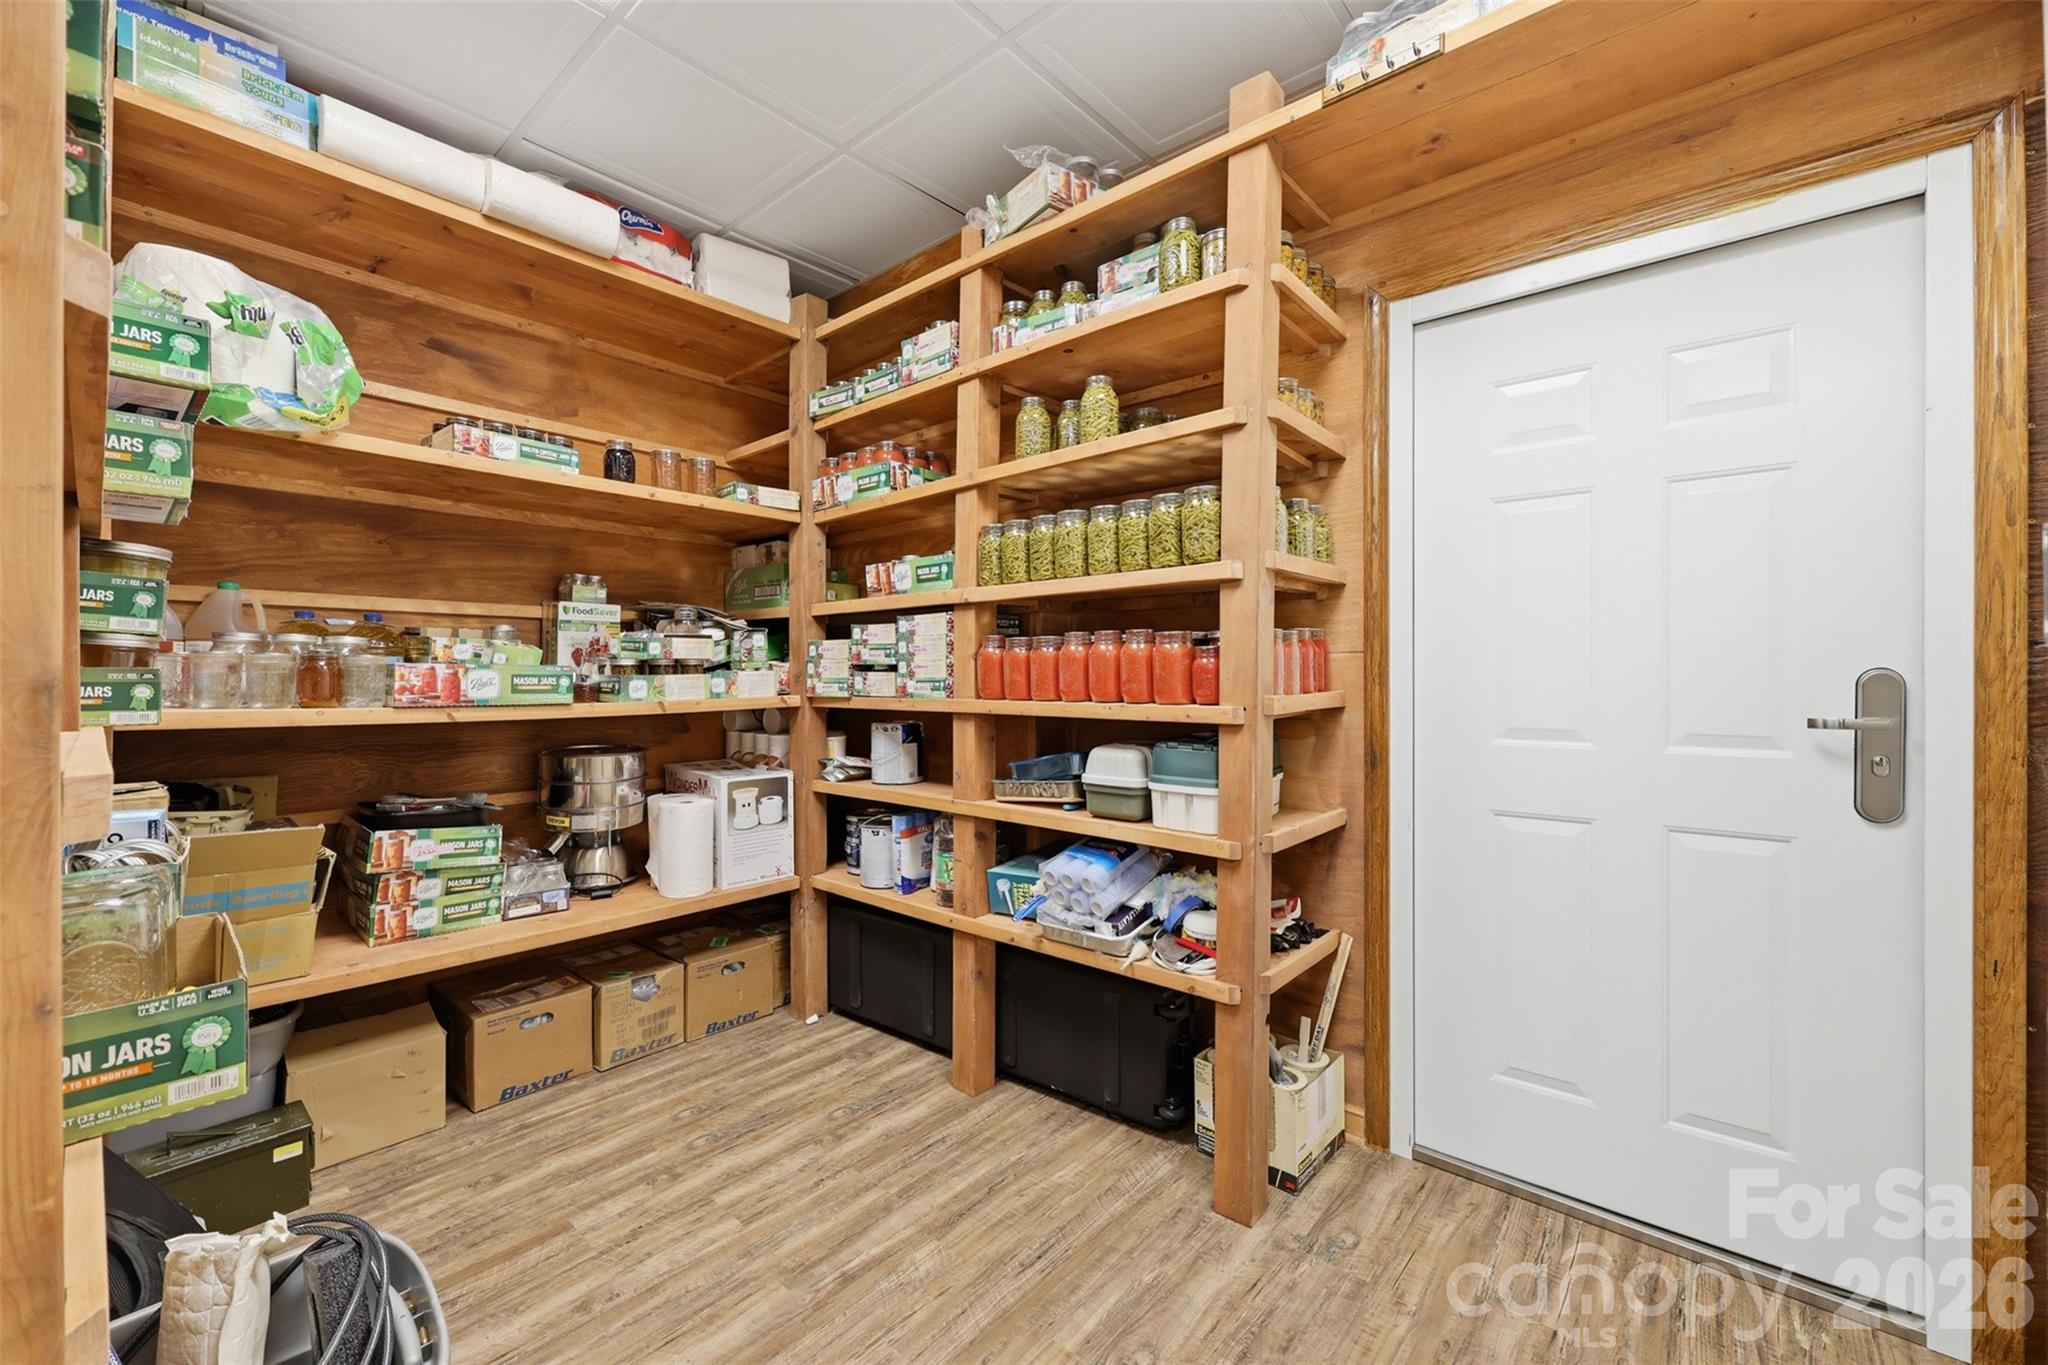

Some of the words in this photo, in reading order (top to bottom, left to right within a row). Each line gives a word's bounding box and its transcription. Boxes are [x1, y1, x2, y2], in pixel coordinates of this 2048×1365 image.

[621, 209, 654, 228] Charmin
[119, 323, 163, 344] JARS
[80, 587, 115, 602] JARS
[512, 676, 539, 685] MASON
[539, 676, 558, 685] JARS
[80, 685, 112, 698] JARS
[466, 839, 484, 848] JARS
[447, 878, 473, 888] MASON
[443, 903, 470, 915] MASON
[469, 900, 487, 911] JARS
[705, 1010, 759, 1035] Baxter
[101, 1033, 172, 1069] JARS
[610, 1032, 677, 1064] Baxter
[70, 1082, 82, 1091] TO
[100, 1067, 140, 1083] MONTHS
[499, 1068, 574, 1103] Baxter
